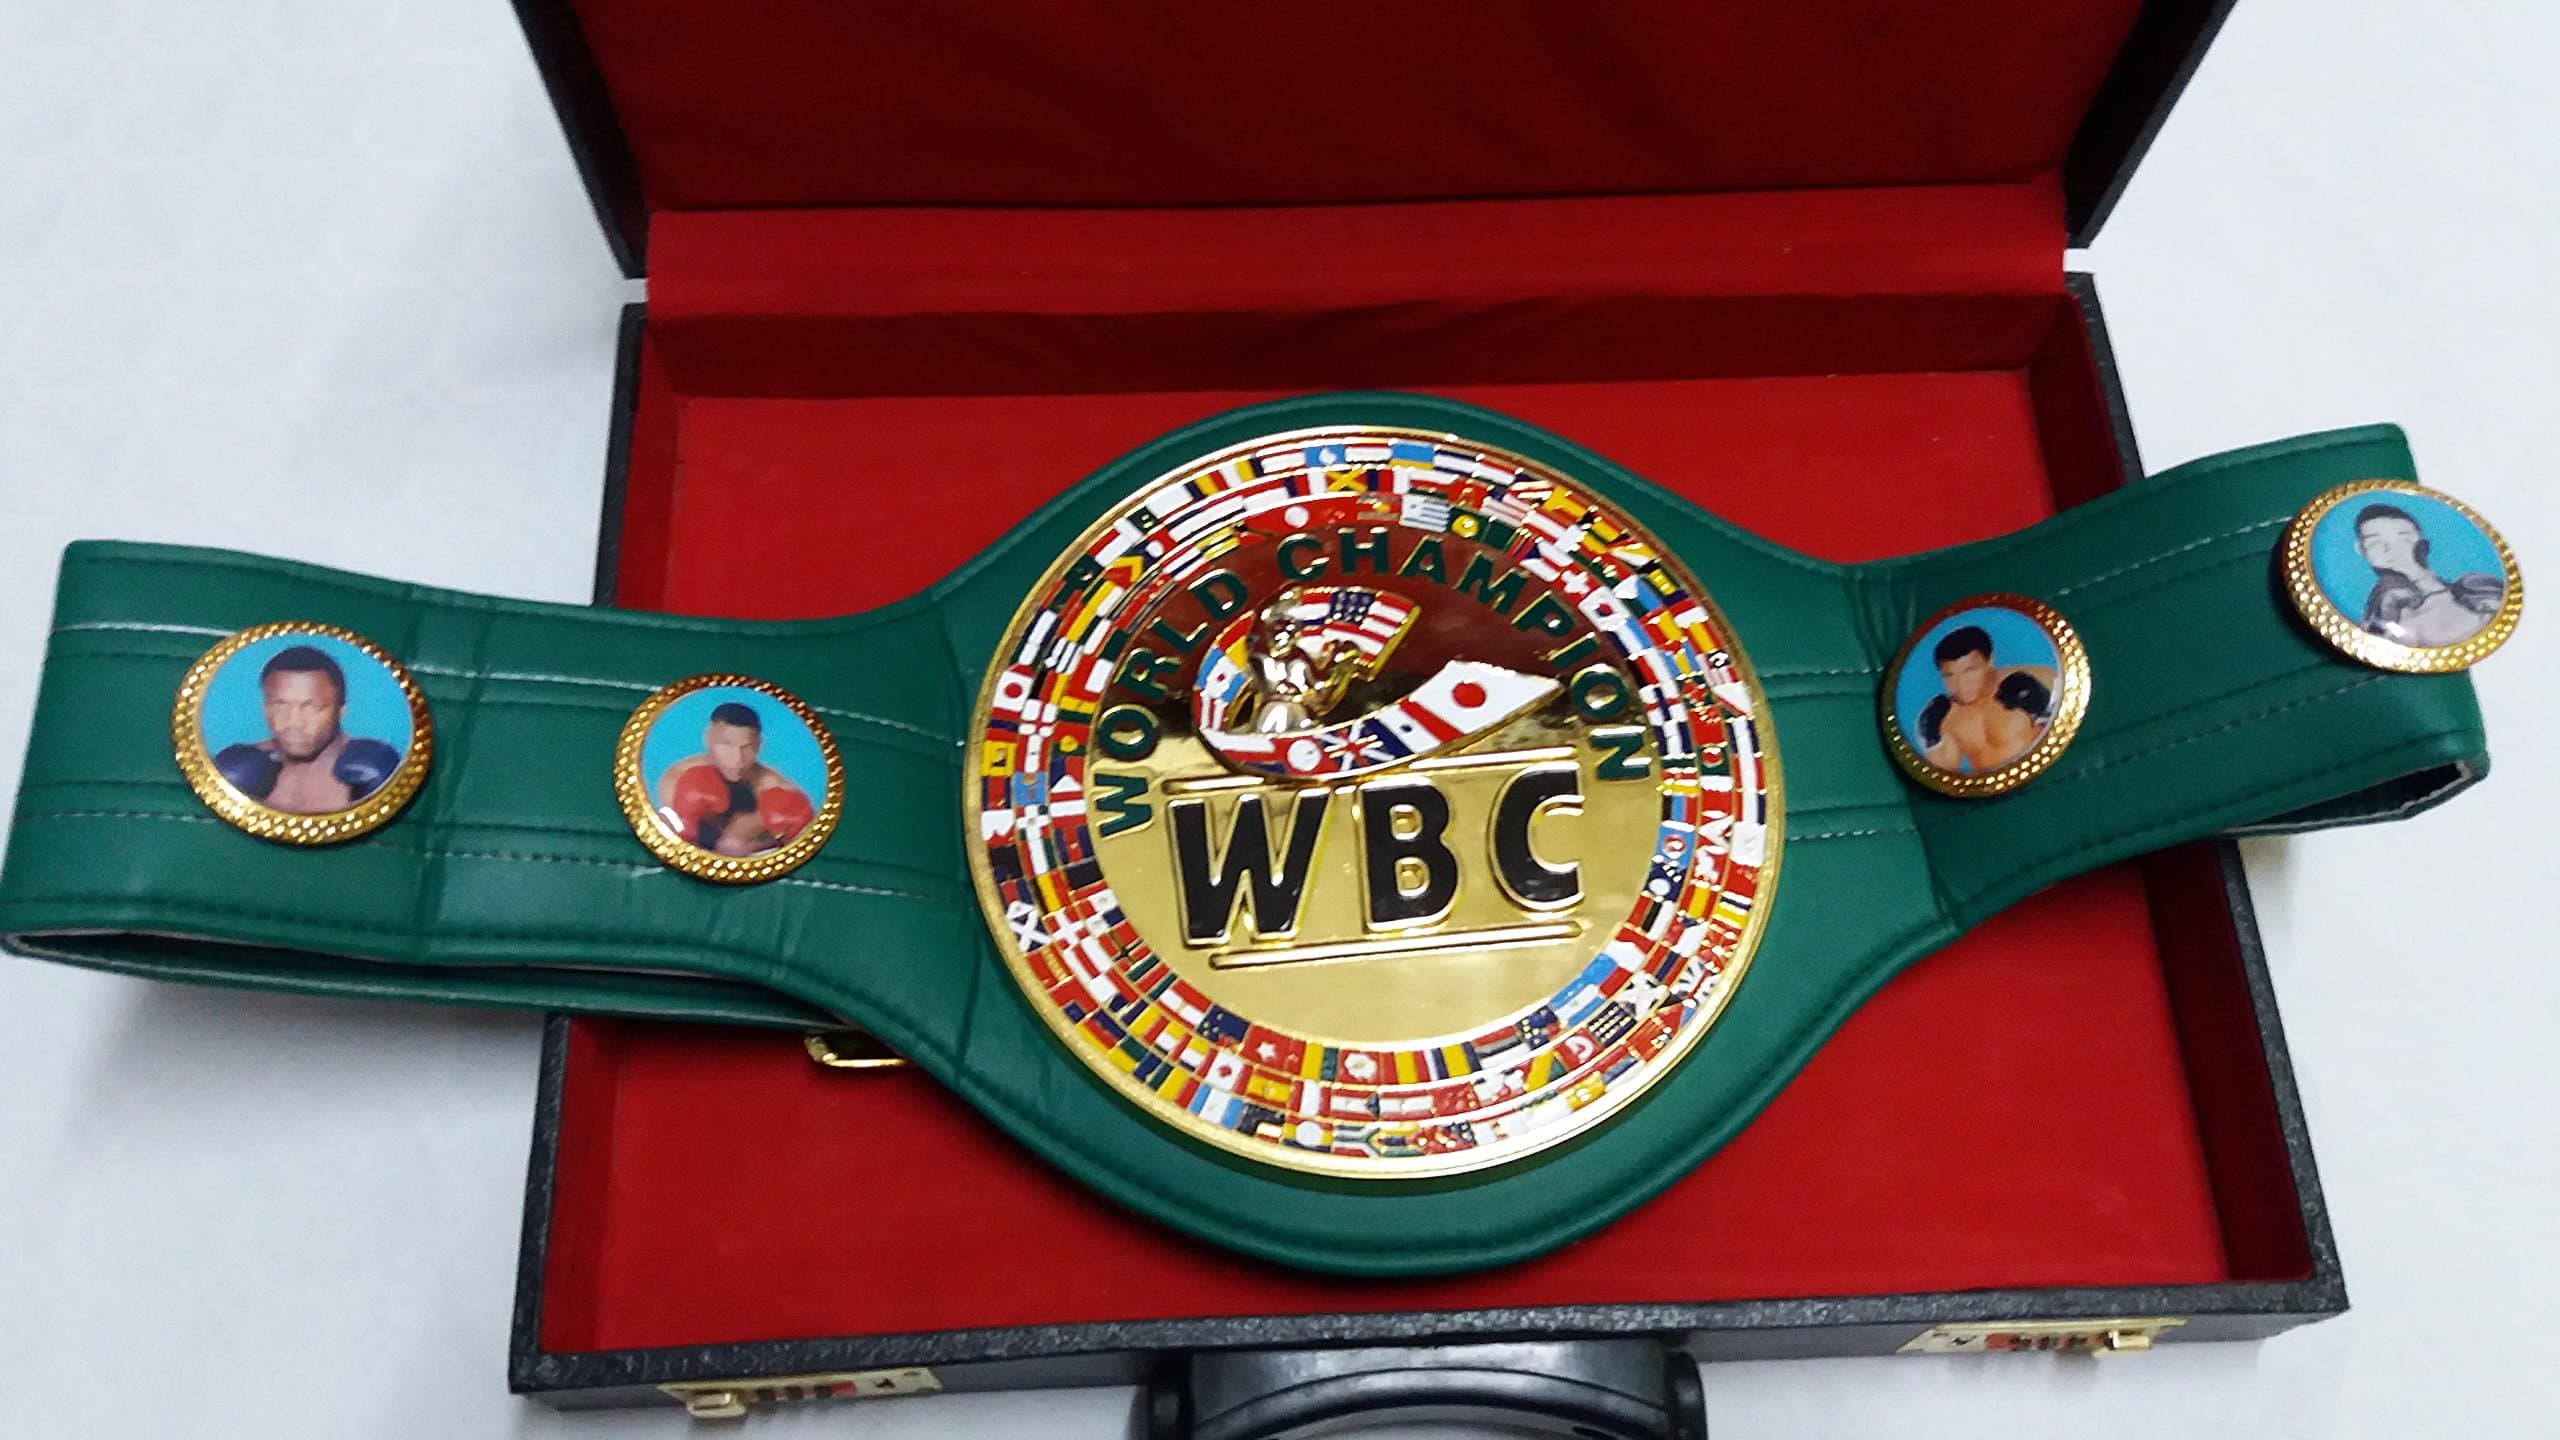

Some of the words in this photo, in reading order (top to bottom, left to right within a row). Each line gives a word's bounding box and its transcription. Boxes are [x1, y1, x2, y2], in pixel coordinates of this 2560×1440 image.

[1093, 568, 1250, 839] WORLD
[1277, 526, 1652, 781] CHAMPION
[1166, 760, 1586, 948] WBC
